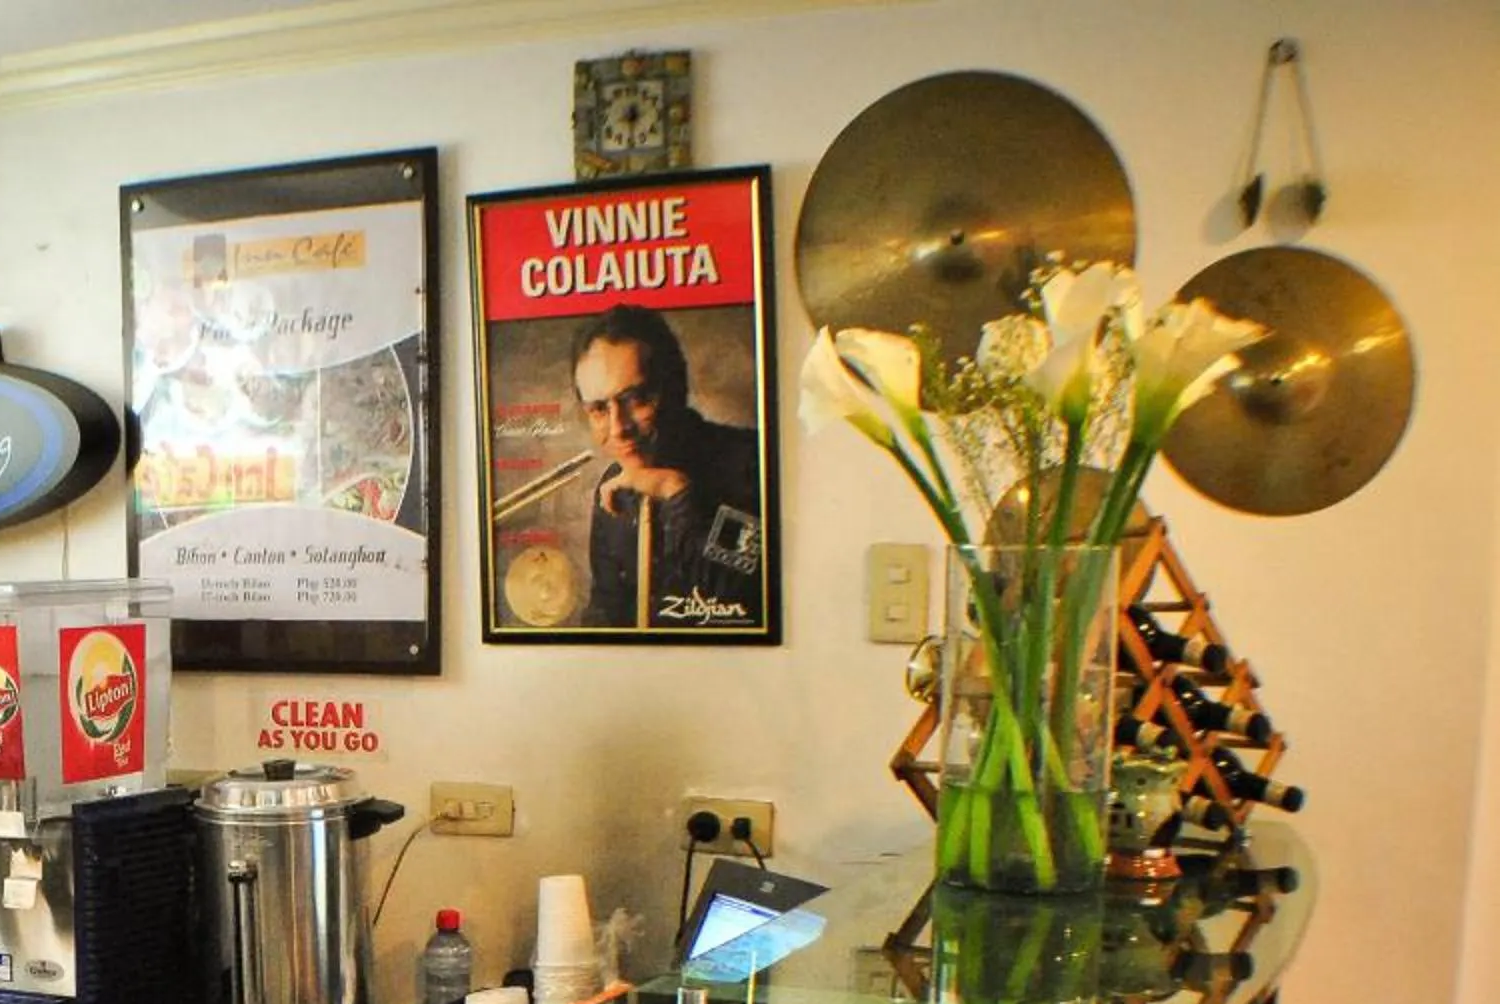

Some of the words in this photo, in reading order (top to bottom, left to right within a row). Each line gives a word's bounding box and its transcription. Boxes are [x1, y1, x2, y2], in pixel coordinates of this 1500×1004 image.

[545, 197, 688, 248] VINNIE
[521, 244, 720, 298] COLAIUTA
[268, 306, 354, 340] Package
[233, 546, 286, 565] Canton
[657, 585, 748, 625] Zildjian
[87, 682, 130, 714] Lipton
[271, 700, 364, 728] CLEAN
[257, 729, 285, 749] AS
[290, 730, 337, 751] YOU
[343, 732, 379, 752] GO
